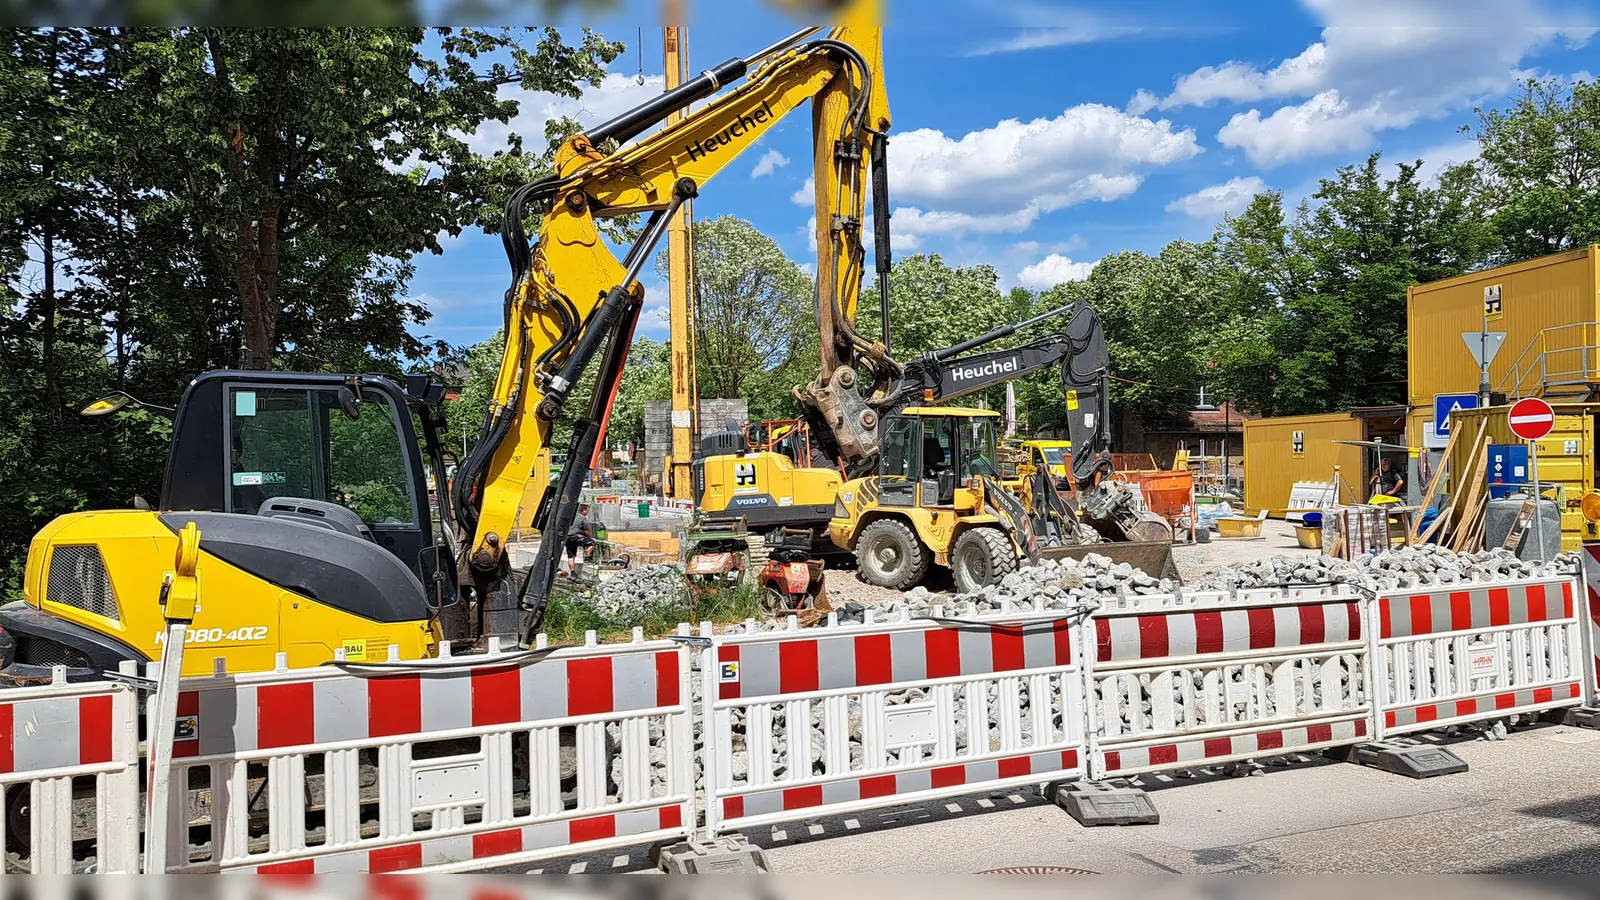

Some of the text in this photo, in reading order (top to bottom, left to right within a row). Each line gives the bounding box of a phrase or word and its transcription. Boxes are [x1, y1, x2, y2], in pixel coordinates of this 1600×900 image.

[684, 100, 774, 162] Heuchel
[952, 357, 1017, 381] Heuchel
[736, 497, 767, 505] VOLVO
[844, 493, 853, 501] 20
[993, 488, 1013, 511] VOLVO
[154, 626, 268, 645] K080-4α2
